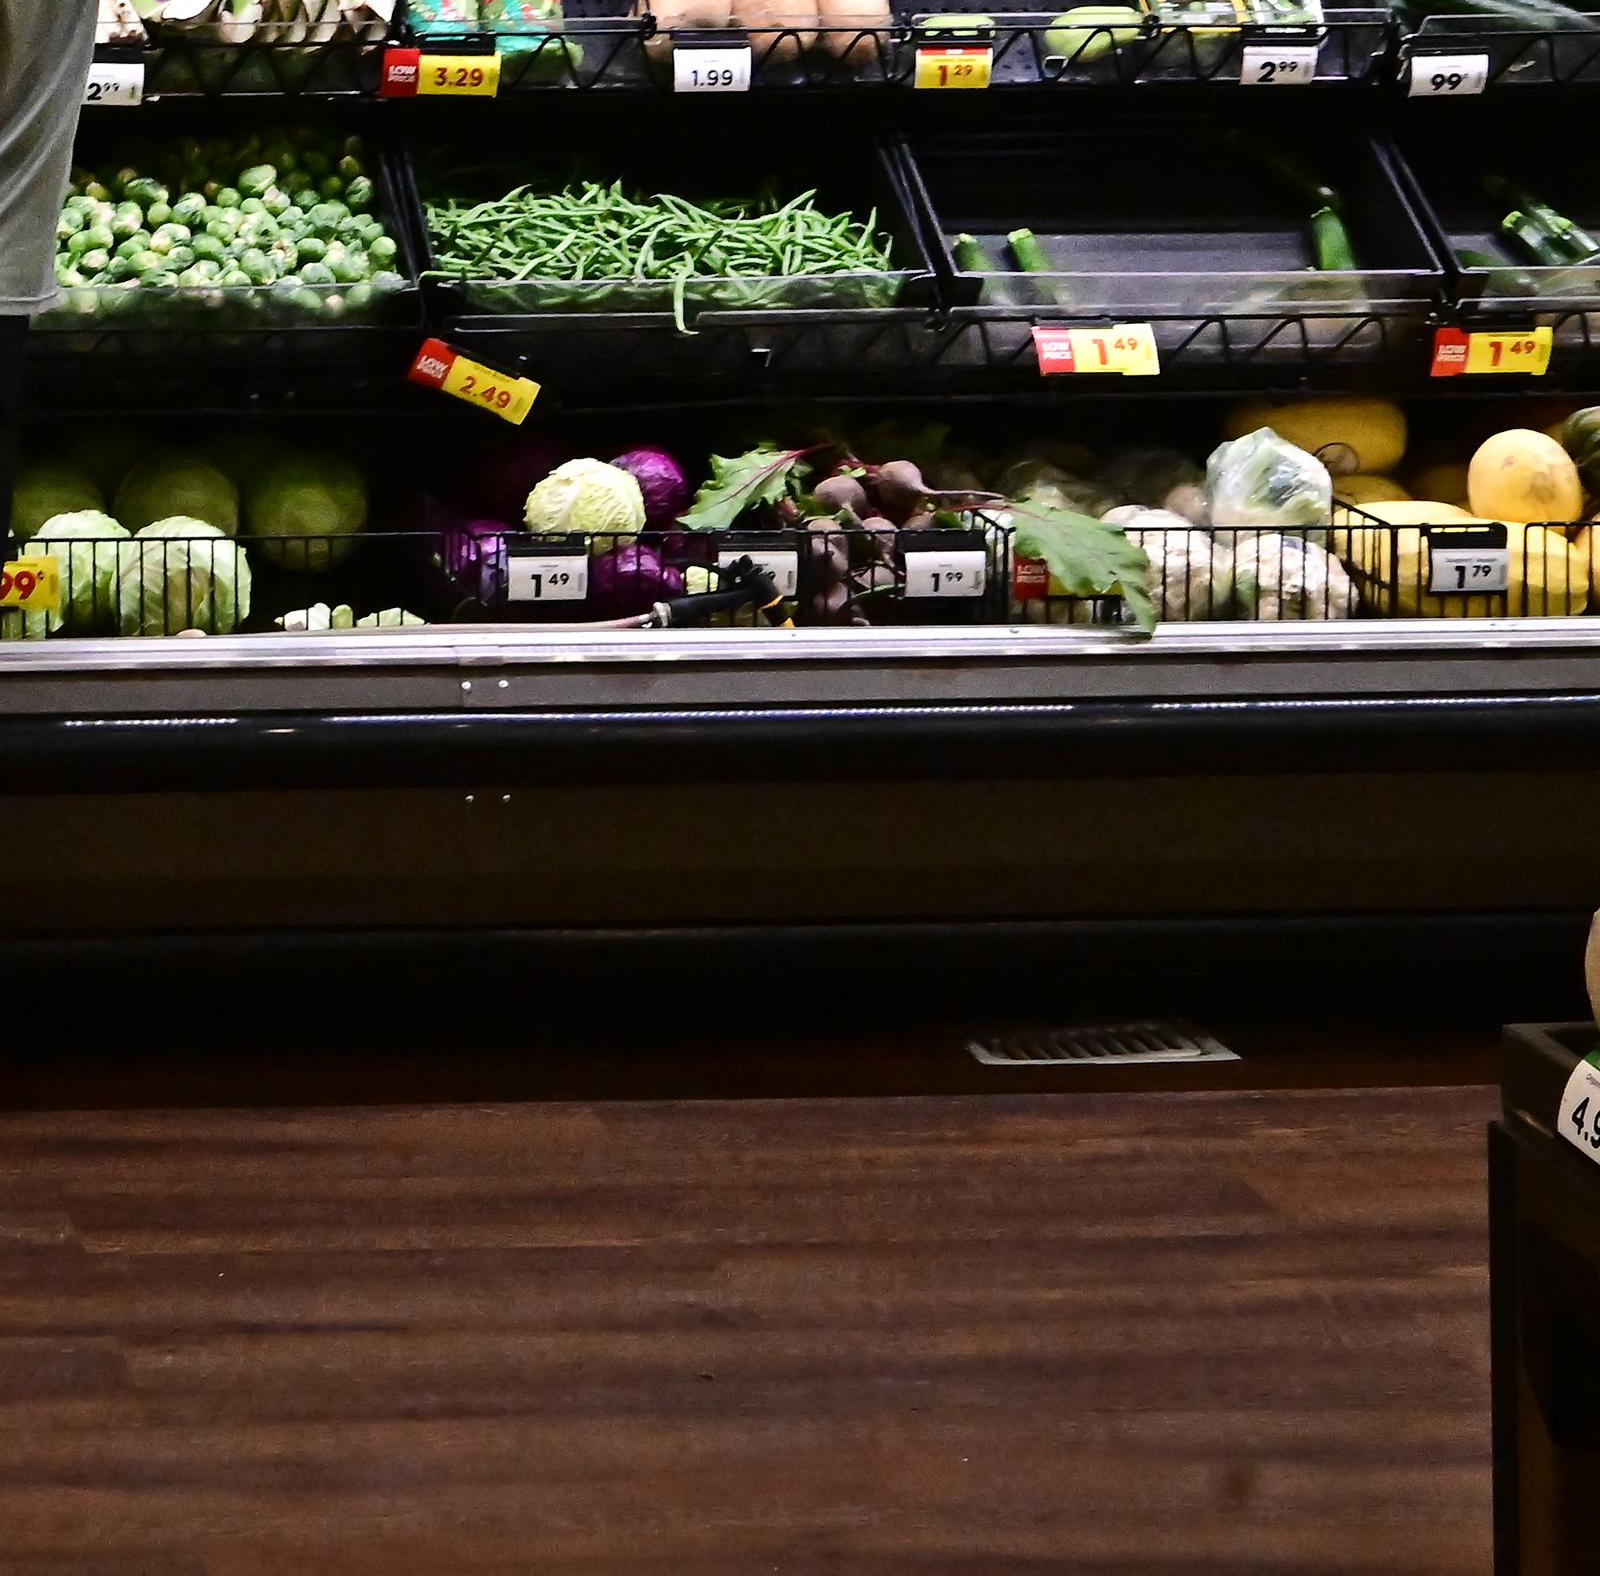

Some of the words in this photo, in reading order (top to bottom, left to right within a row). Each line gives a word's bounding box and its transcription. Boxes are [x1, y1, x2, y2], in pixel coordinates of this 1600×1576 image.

[434, 67, 483, 87] 3.29
[690, 69, 734, 87] 1.99
[1042, 340, 1070, 352] LOW
[1439, 345, 1467, 355] LOW
[460, 375, 512, 410] 2.49
